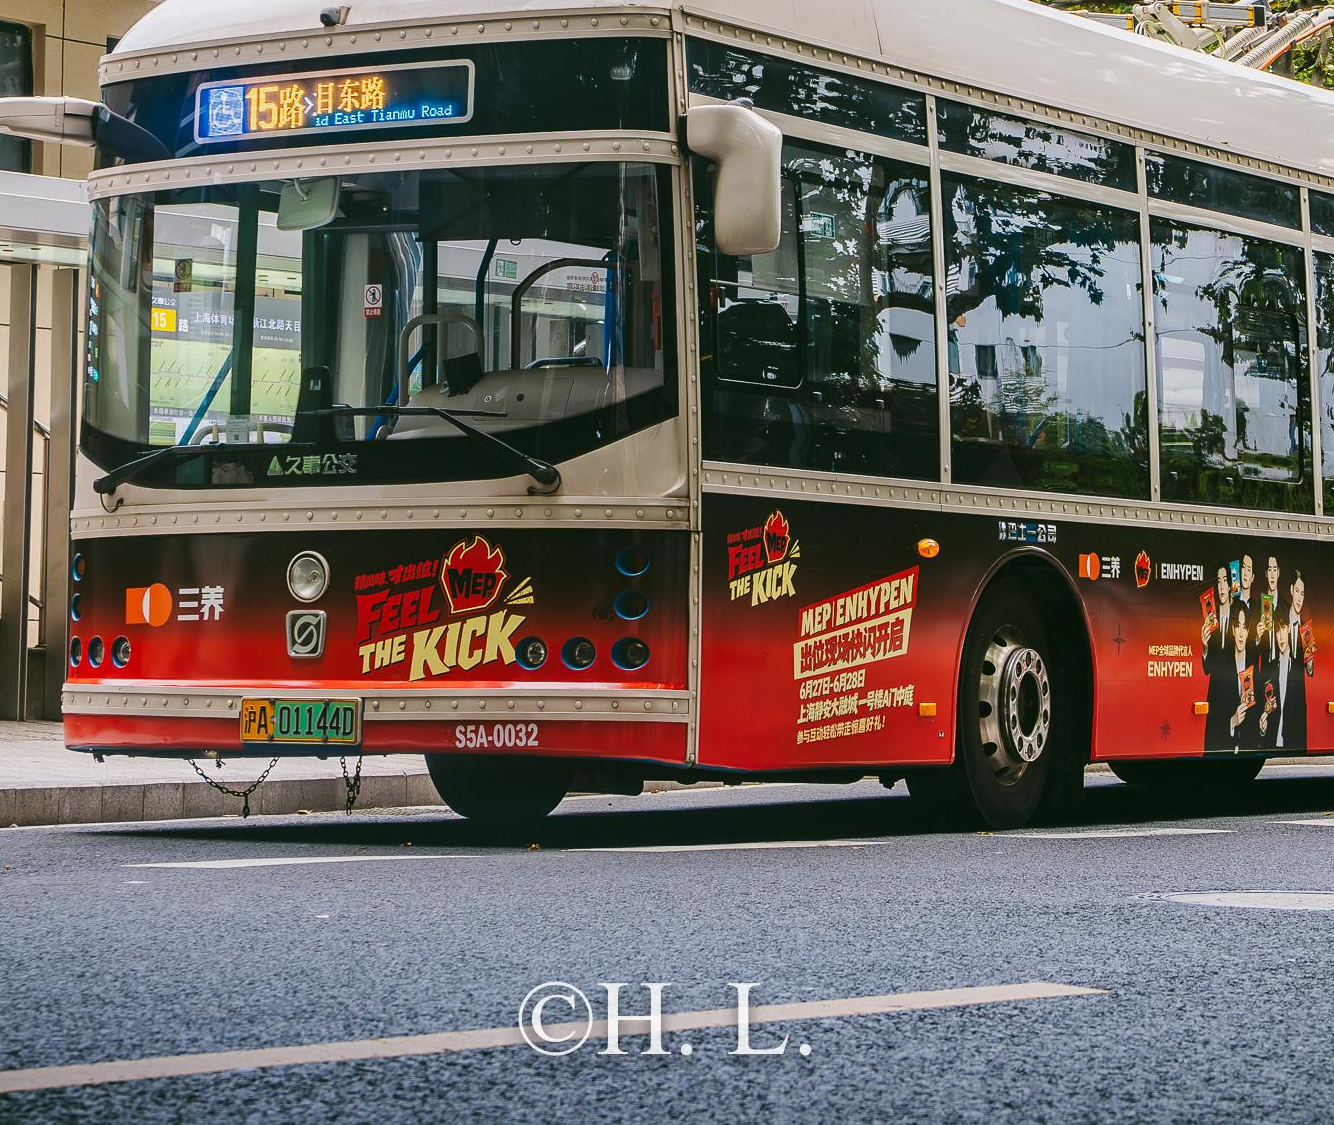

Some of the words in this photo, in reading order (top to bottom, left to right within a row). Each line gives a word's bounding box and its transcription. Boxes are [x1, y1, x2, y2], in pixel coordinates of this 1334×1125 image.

[245, 83, 306, 131] 15路
[335, 110, 365, 125] East
[371, 104, 415, 122] Tianmu
[421, 104, 453, 119] Road
[153, 312, 167, 328] 15
[178, 318, 189, 332] 路
[285, 453, 357, 475] 久事公交
[1008, 522, 1057, 543] 巴士一公司
[728, 543, 764, 581] FEEL
[1101, 556, 1121, 579] 三养
[1161, 562, 1204, 581] ENHYPEN
[448, 568, 497, 599] MEP
[729, 575, 751, 601] THE
[751, 560, 798, 607] KICK
[178, 585, 224, 621] 三养
[355, 584, 440, 644] FEEL
[358, 634, 407, 674] THE
[409, 608, 527, 682] KICK
[799, 668, 866, 700] 6月27日-6月28日
[1147, 661, 1193, 677] ENHYPEN
[455, 723, 539, 749] S5A-0032
